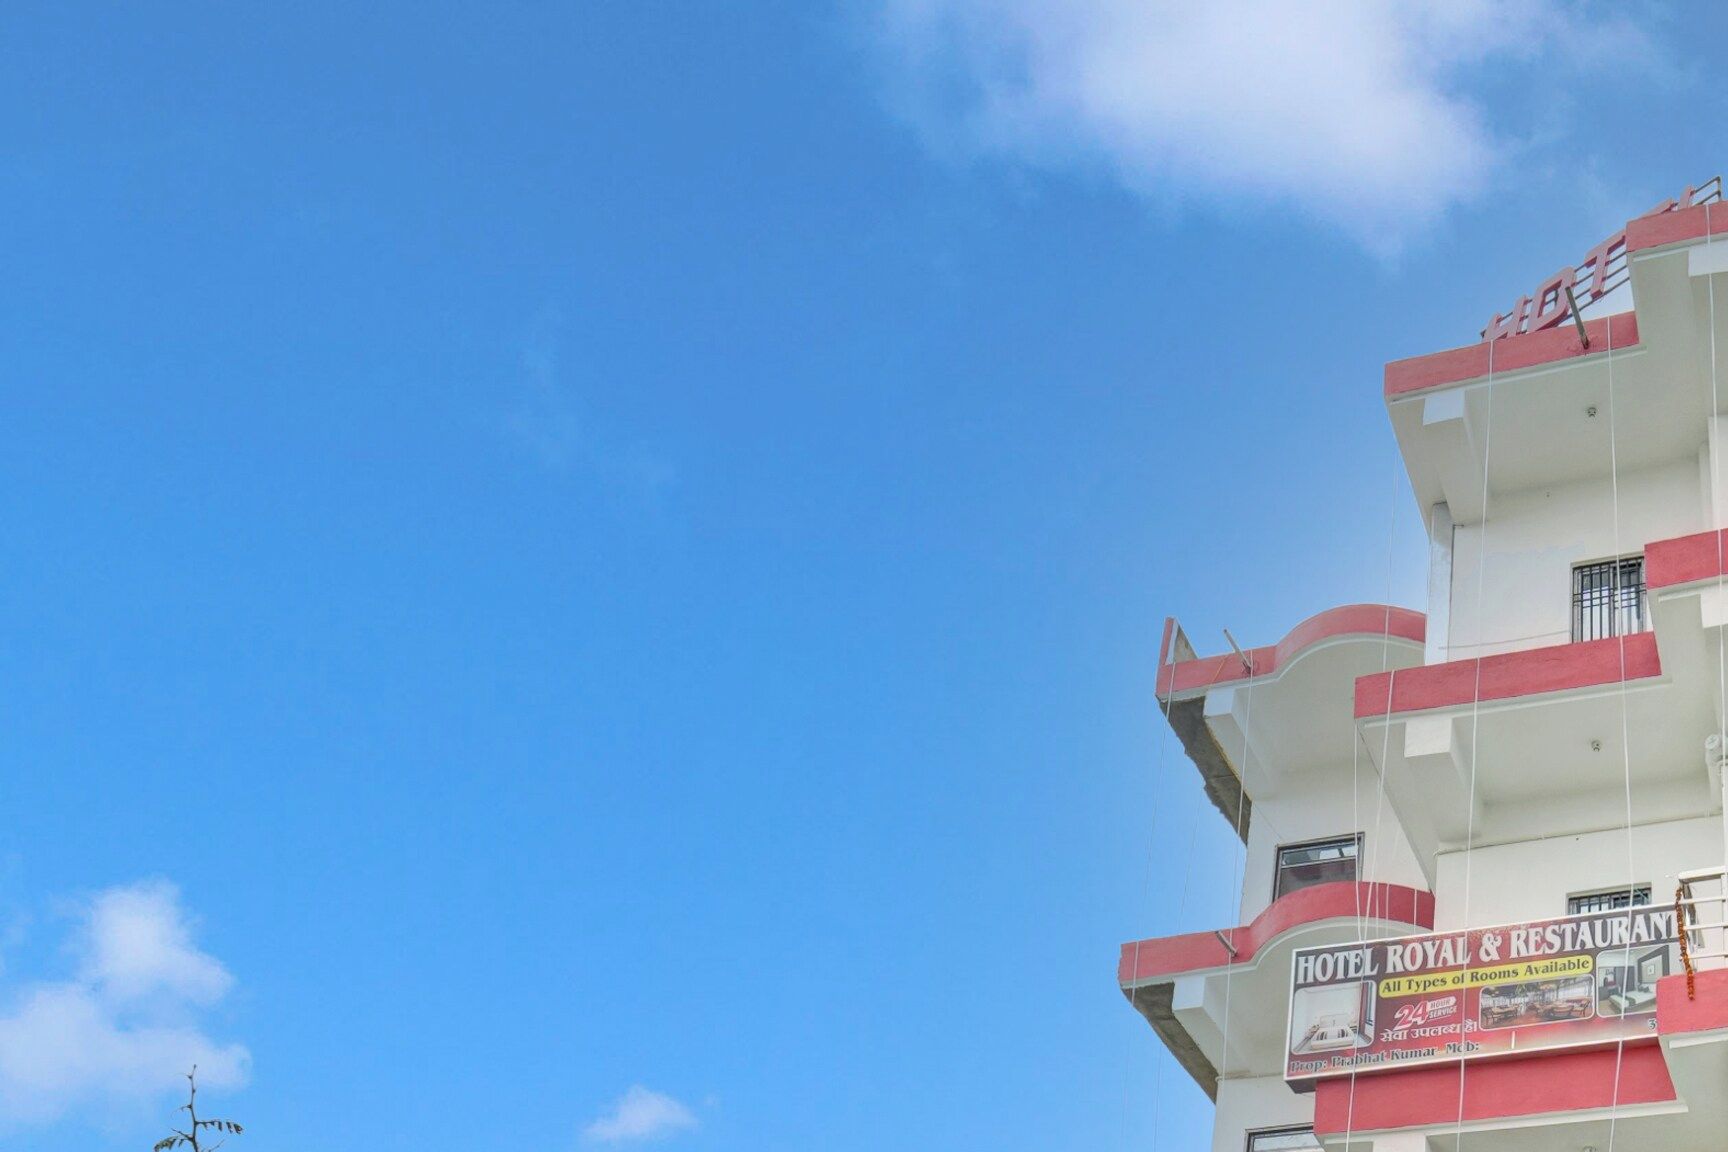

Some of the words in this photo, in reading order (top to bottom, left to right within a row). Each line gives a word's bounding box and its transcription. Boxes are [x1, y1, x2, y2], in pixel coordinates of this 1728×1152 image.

[1296, 947, 1379, 984] HOTEL
[1385, 936, 1471, 974] ROYAL
[1479, 932, 1503, 963] &
[1382, 979, 1401, 995] All
[1406, 973, 1447, 994] Types
[1451, 976, 1467, 986] of
[1470, 966, 1519, 984] Rooms
[1524, 956, 1590, 976] Available
[1393, 1000, 1428, 1031] 24
[1429, 1005, 1457, 1018] SERVICE
[1430, 998, 1451, 1008] HOUR
[1380, 1028, 1408, 1043] सेवा
[1410, 1023, 1461, 1039] उपलब्ध
[1291, 1060, 1328, 1073] Prop:
[1331, 1054, 1386, 1069] Prabhat
[1390, 1047, 1436, 1061] Kumar
